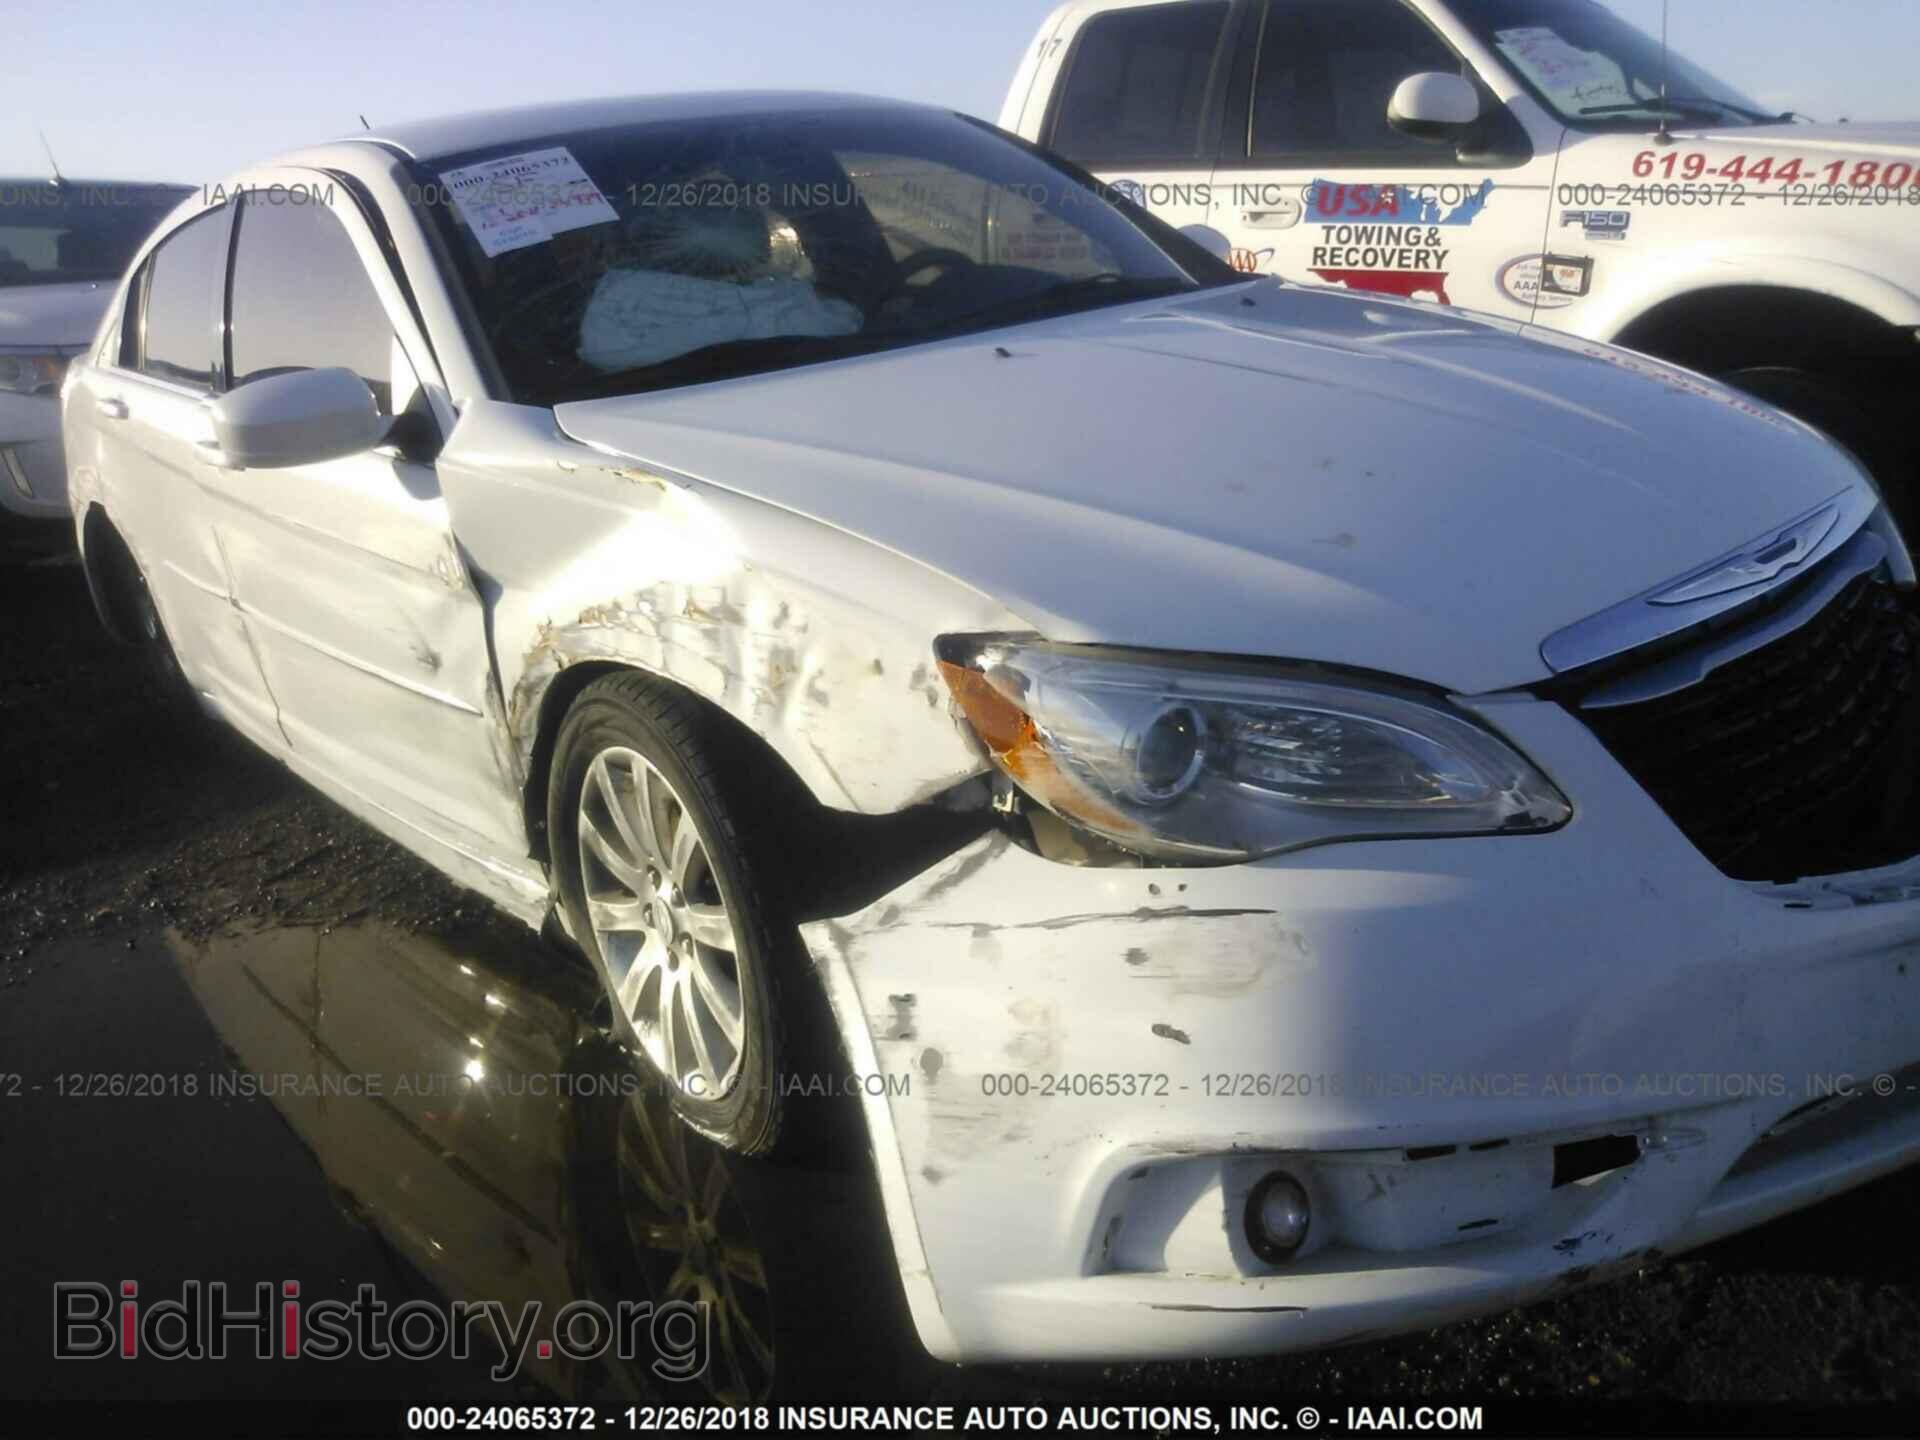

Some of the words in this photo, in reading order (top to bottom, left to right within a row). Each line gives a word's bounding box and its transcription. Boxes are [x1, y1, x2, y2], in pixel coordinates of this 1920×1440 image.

[1632, 150, 1920, 189] 619-444-180
[1316, 184, 1400, 217] USA
[1310, 246, 1450, 270] RECOVERY
